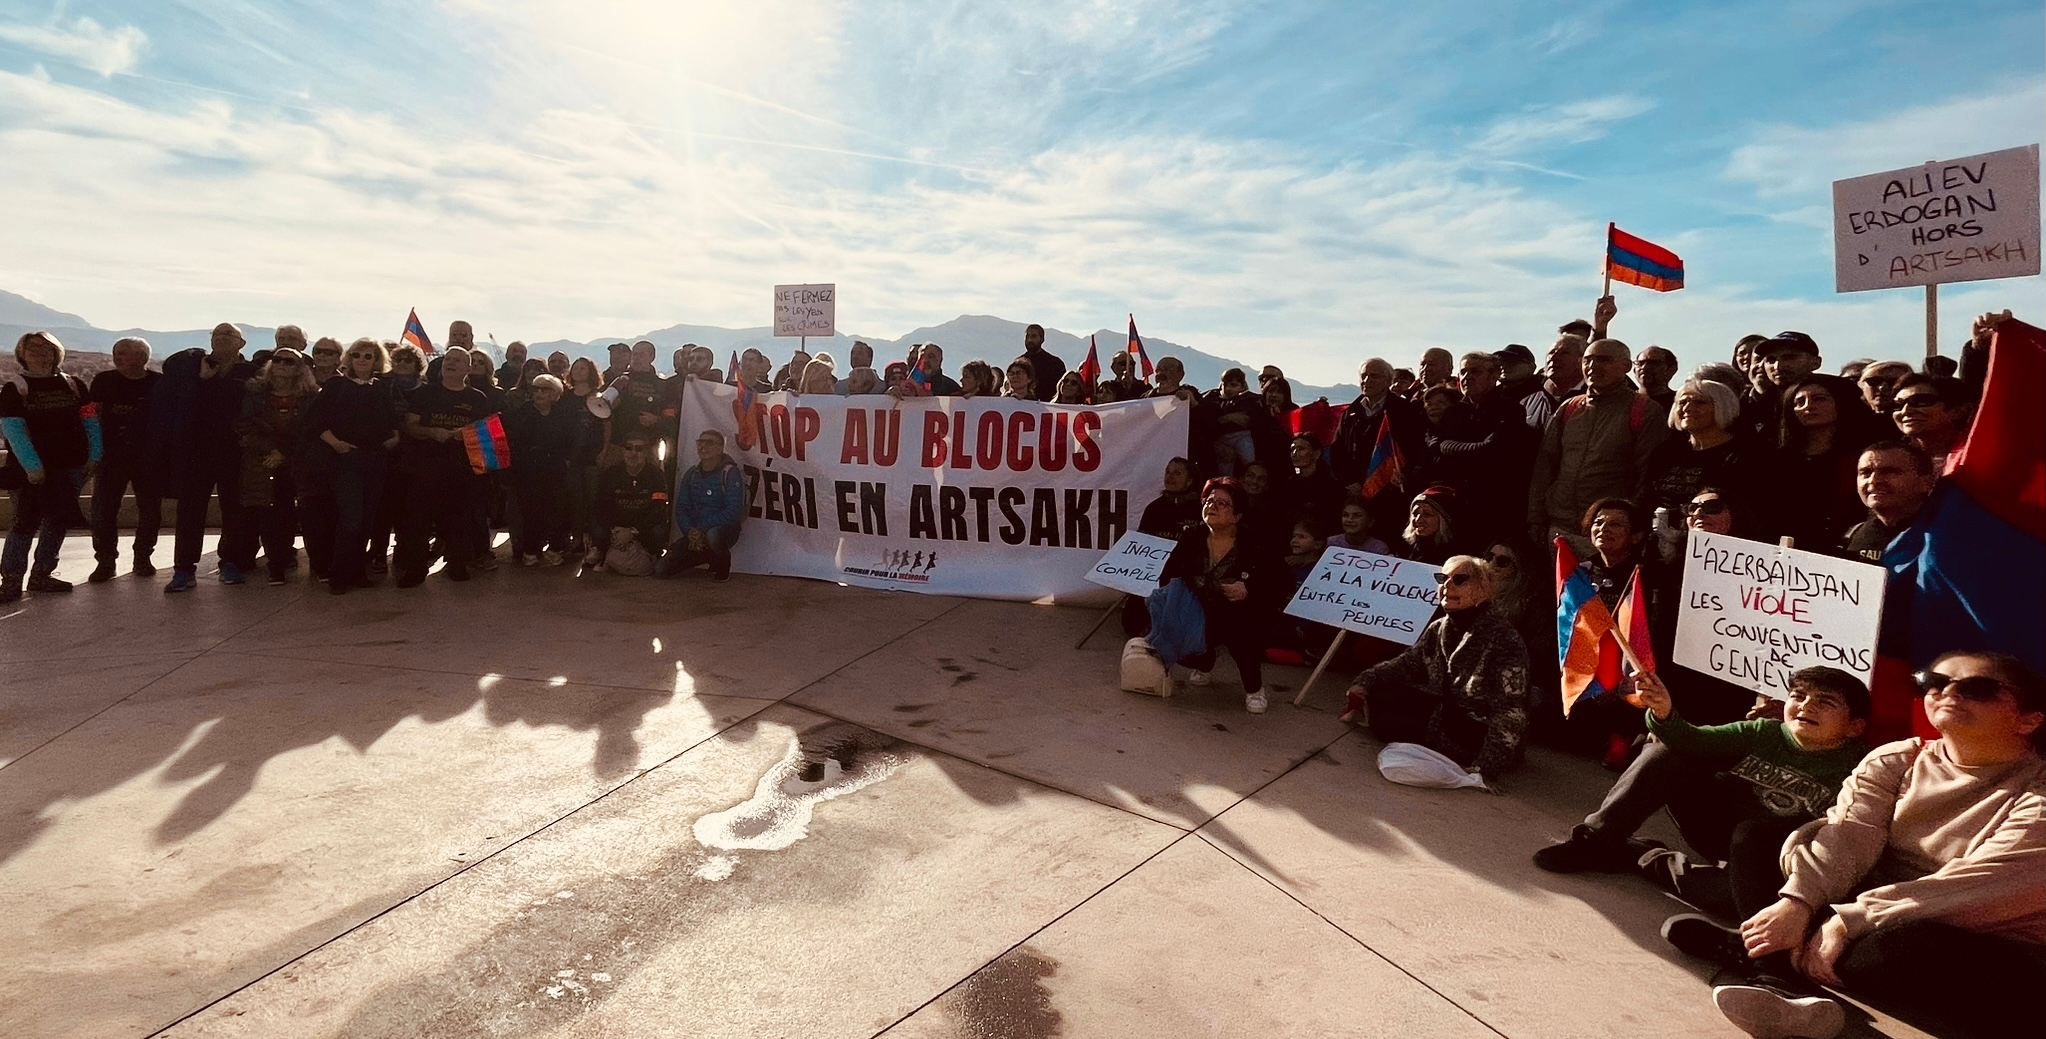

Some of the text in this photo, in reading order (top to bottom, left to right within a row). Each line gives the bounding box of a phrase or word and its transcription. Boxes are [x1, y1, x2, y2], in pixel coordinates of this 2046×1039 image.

[1883, 162, 1987, 203] ALIEV
[1849, 188, 1997, 234] ERDOGAN
[1912, 219, 1983, 246] HORS
[1889, 239, 2026, 279] ARTSAKH
[776, 290, 833, 304] NE FERMEZ
[840, 408, 901, 467] AU
[921, 410, 1102, 472] BLOCUS
[744, 457, 1128, 550] ZÉRI EN ARTSAKH
[1122, 541, 1171, 560] INACT
[1859, 549, 1883, 561] SAU
[843, 566, 870, 575] COURIR
[870, 569, 888, 578] POUR
[889, 571, 898, 579] LA
[1096, 562, 1160, 583] COMPLIC
[1339, 571, 1362, 588] LA
[1299, 586, 1347, 605] ENTRE
[1690, 591, 1724, 612] LES
[1342, 609, 1415, 633] PEUPLES
[1709, 643, 1791, 692] GENEV
[1770, 647, 1794, 668] DE
